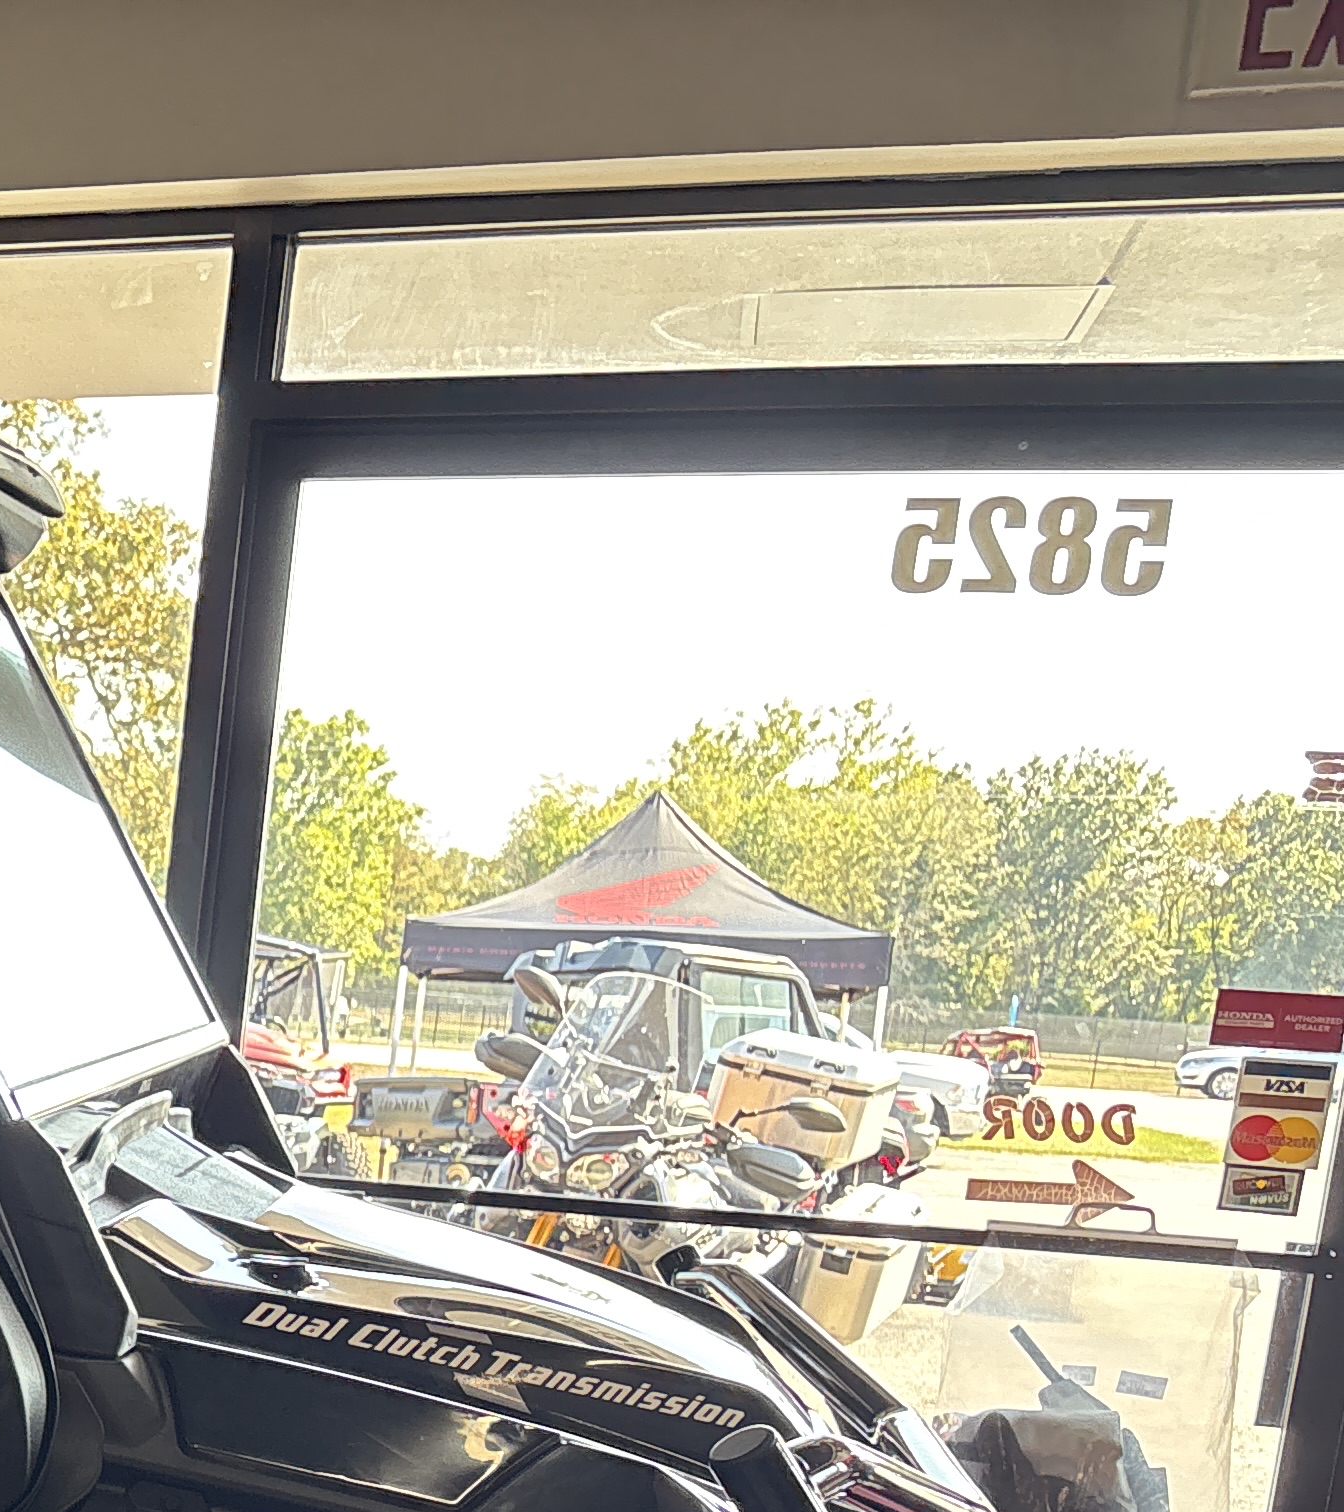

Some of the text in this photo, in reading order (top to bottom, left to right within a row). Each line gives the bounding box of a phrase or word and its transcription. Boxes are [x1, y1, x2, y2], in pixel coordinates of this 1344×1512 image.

[1217, 1010, 1344, 1026] HONDA AUTHORIZED
[1294, 1023, 1331, 1033] DEALER
[1263, 1078, 1306, 1095] VISA
[1249, 1193, 1290, 1205] NOVUS
[241, 1300, 747, 1429] Dual Clutch Transmission
